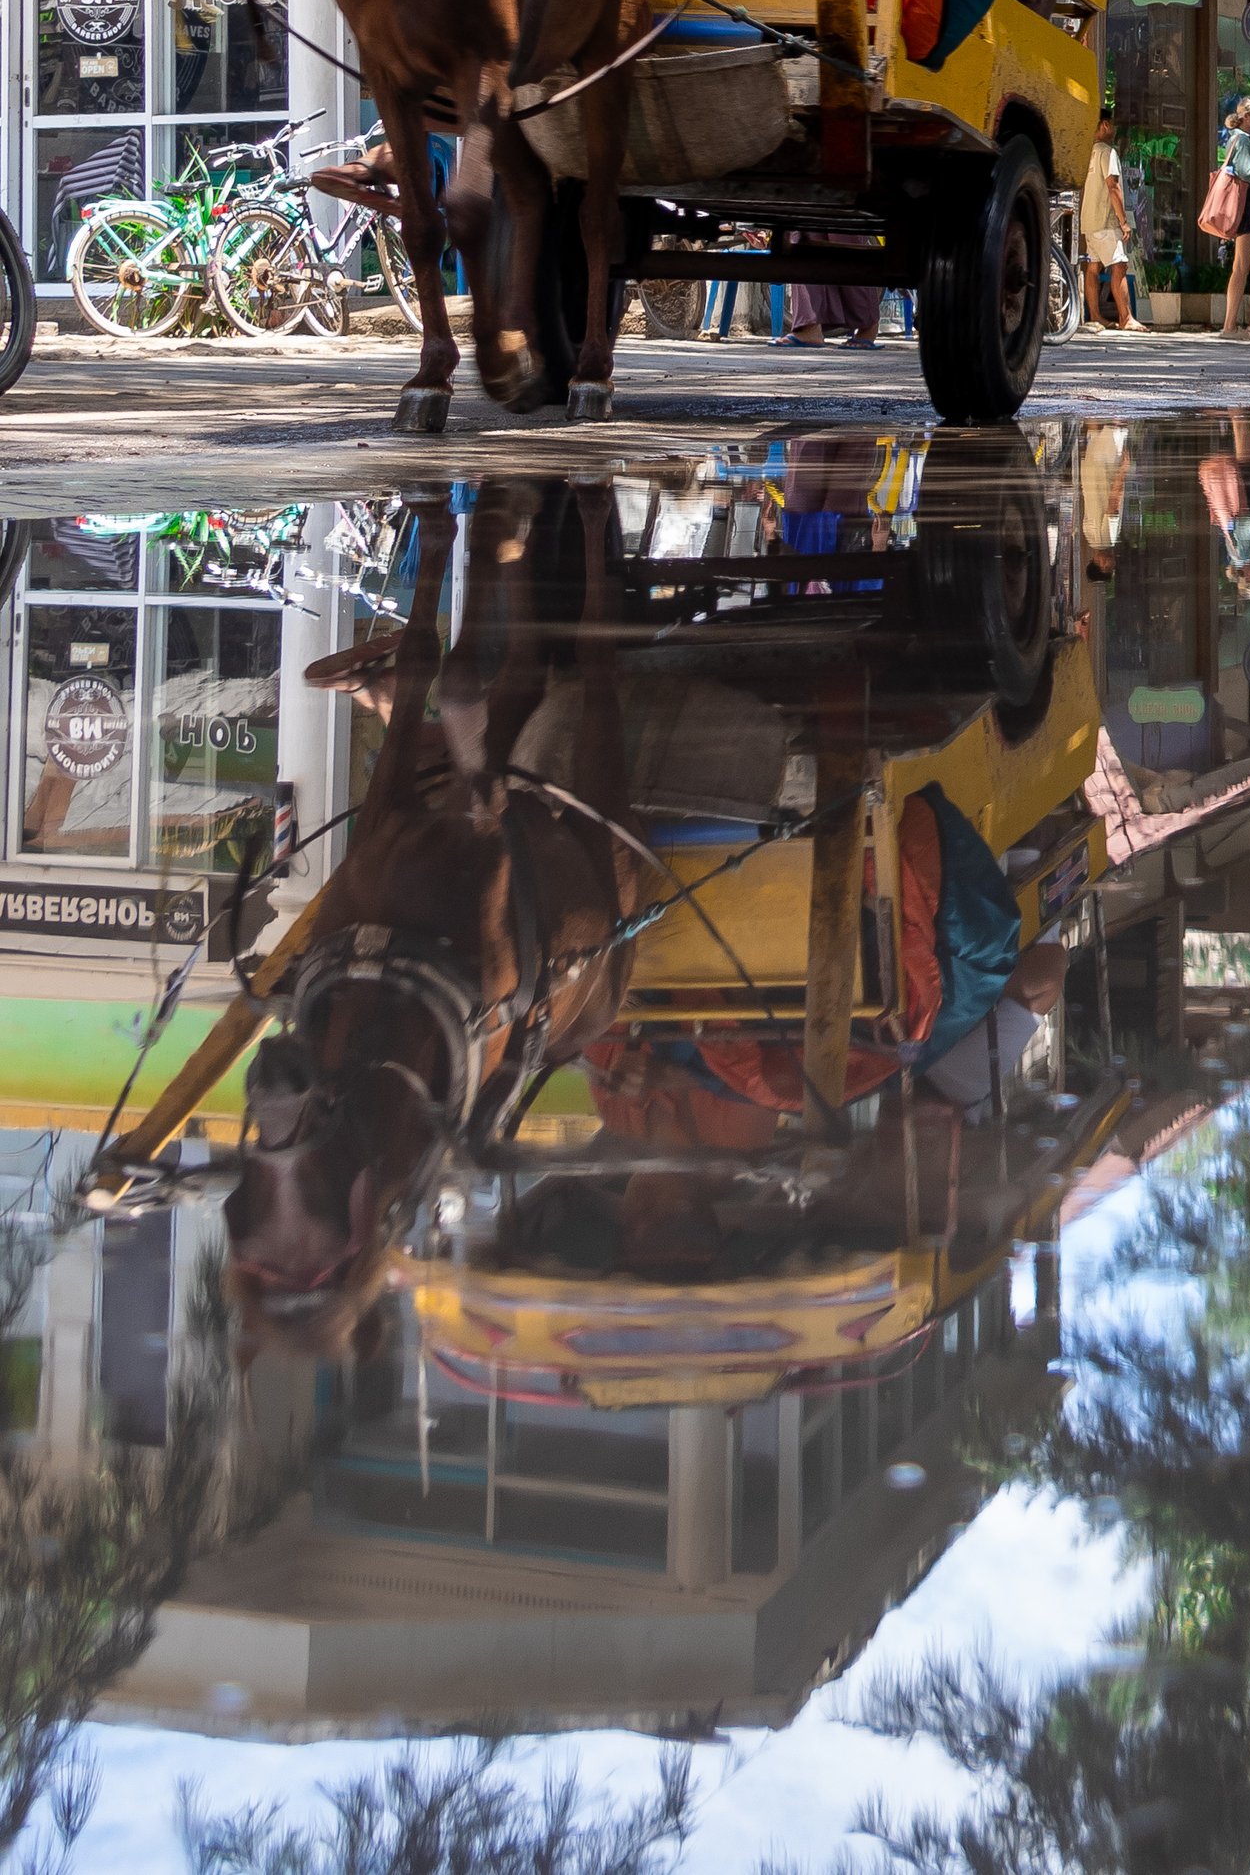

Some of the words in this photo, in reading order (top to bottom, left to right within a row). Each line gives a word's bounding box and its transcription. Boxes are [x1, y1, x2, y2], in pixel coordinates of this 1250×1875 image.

[71, 22, 101, 41] BARBER
[102, 21, 123, 39] SHOP
[81, 65, 104, 74] OPEN
